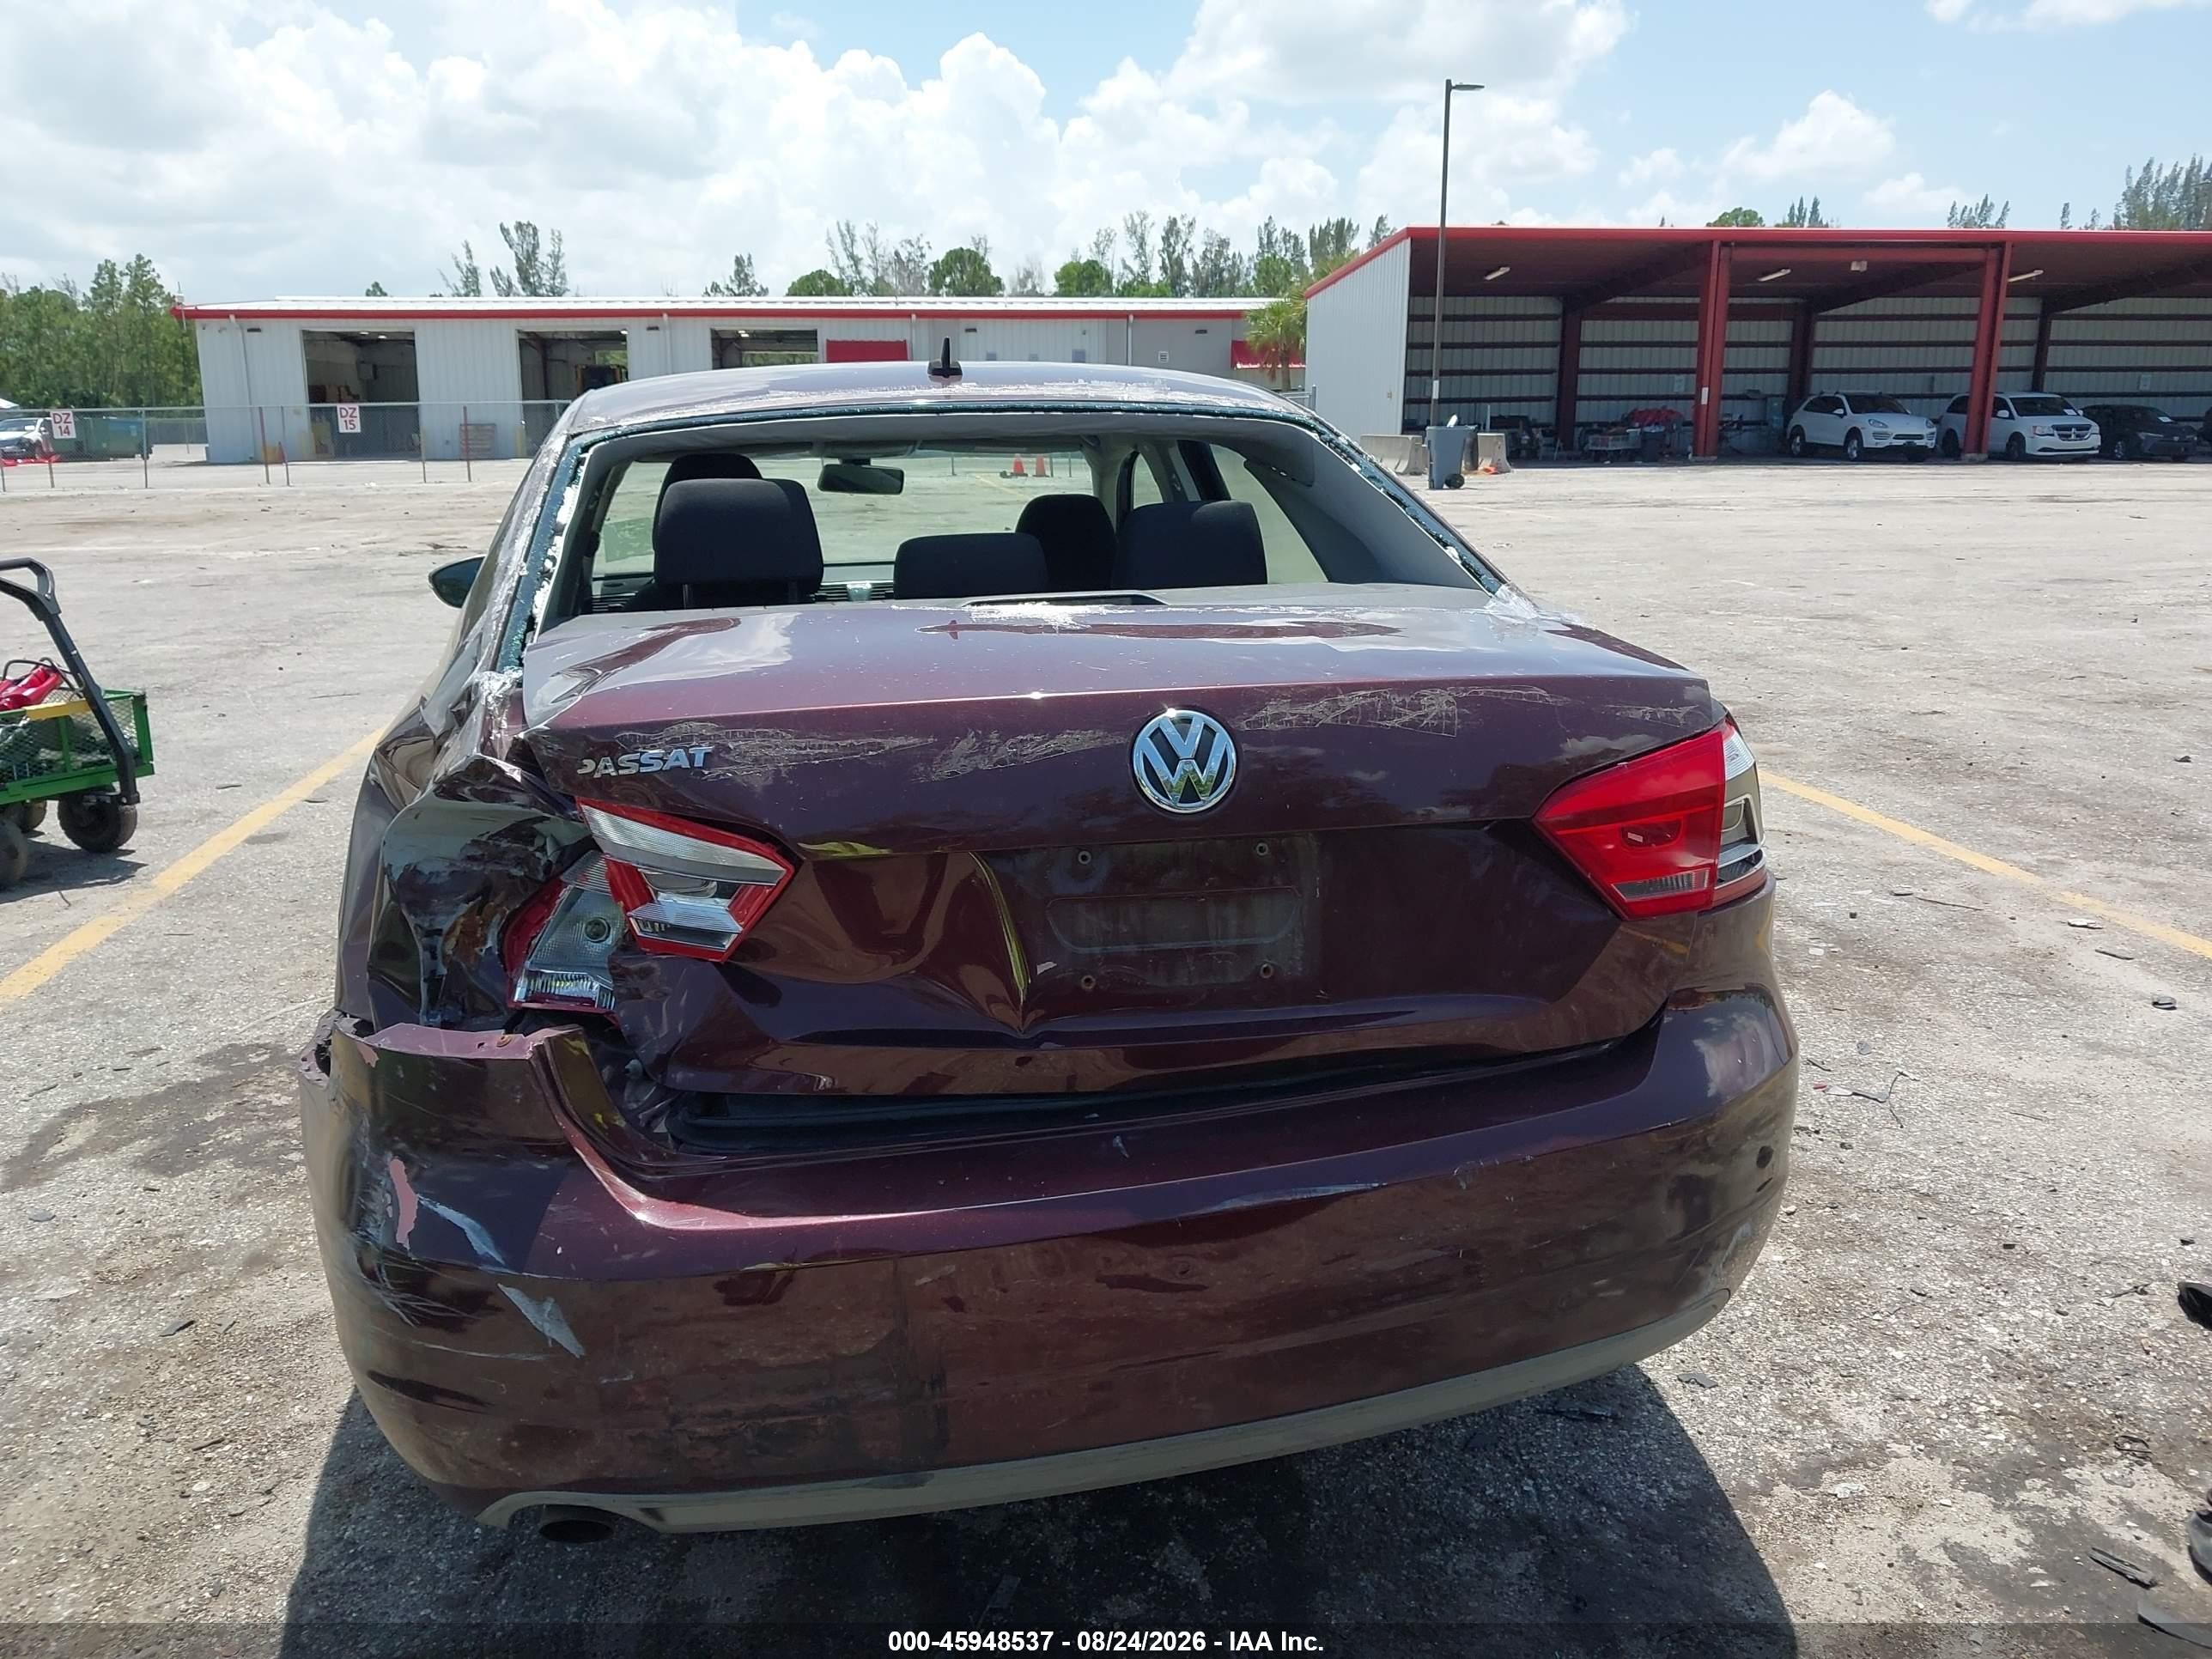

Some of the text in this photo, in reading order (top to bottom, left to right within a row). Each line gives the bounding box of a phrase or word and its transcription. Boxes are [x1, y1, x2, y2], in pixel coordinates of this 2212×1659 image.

[52, 412, 72, 424] DZ
[339, 407, 357, 419] DZ
[58, 425, 70, 436] 14
[343, 419, 356, 430] 15
[1135, 711, 1232, 811] VW
